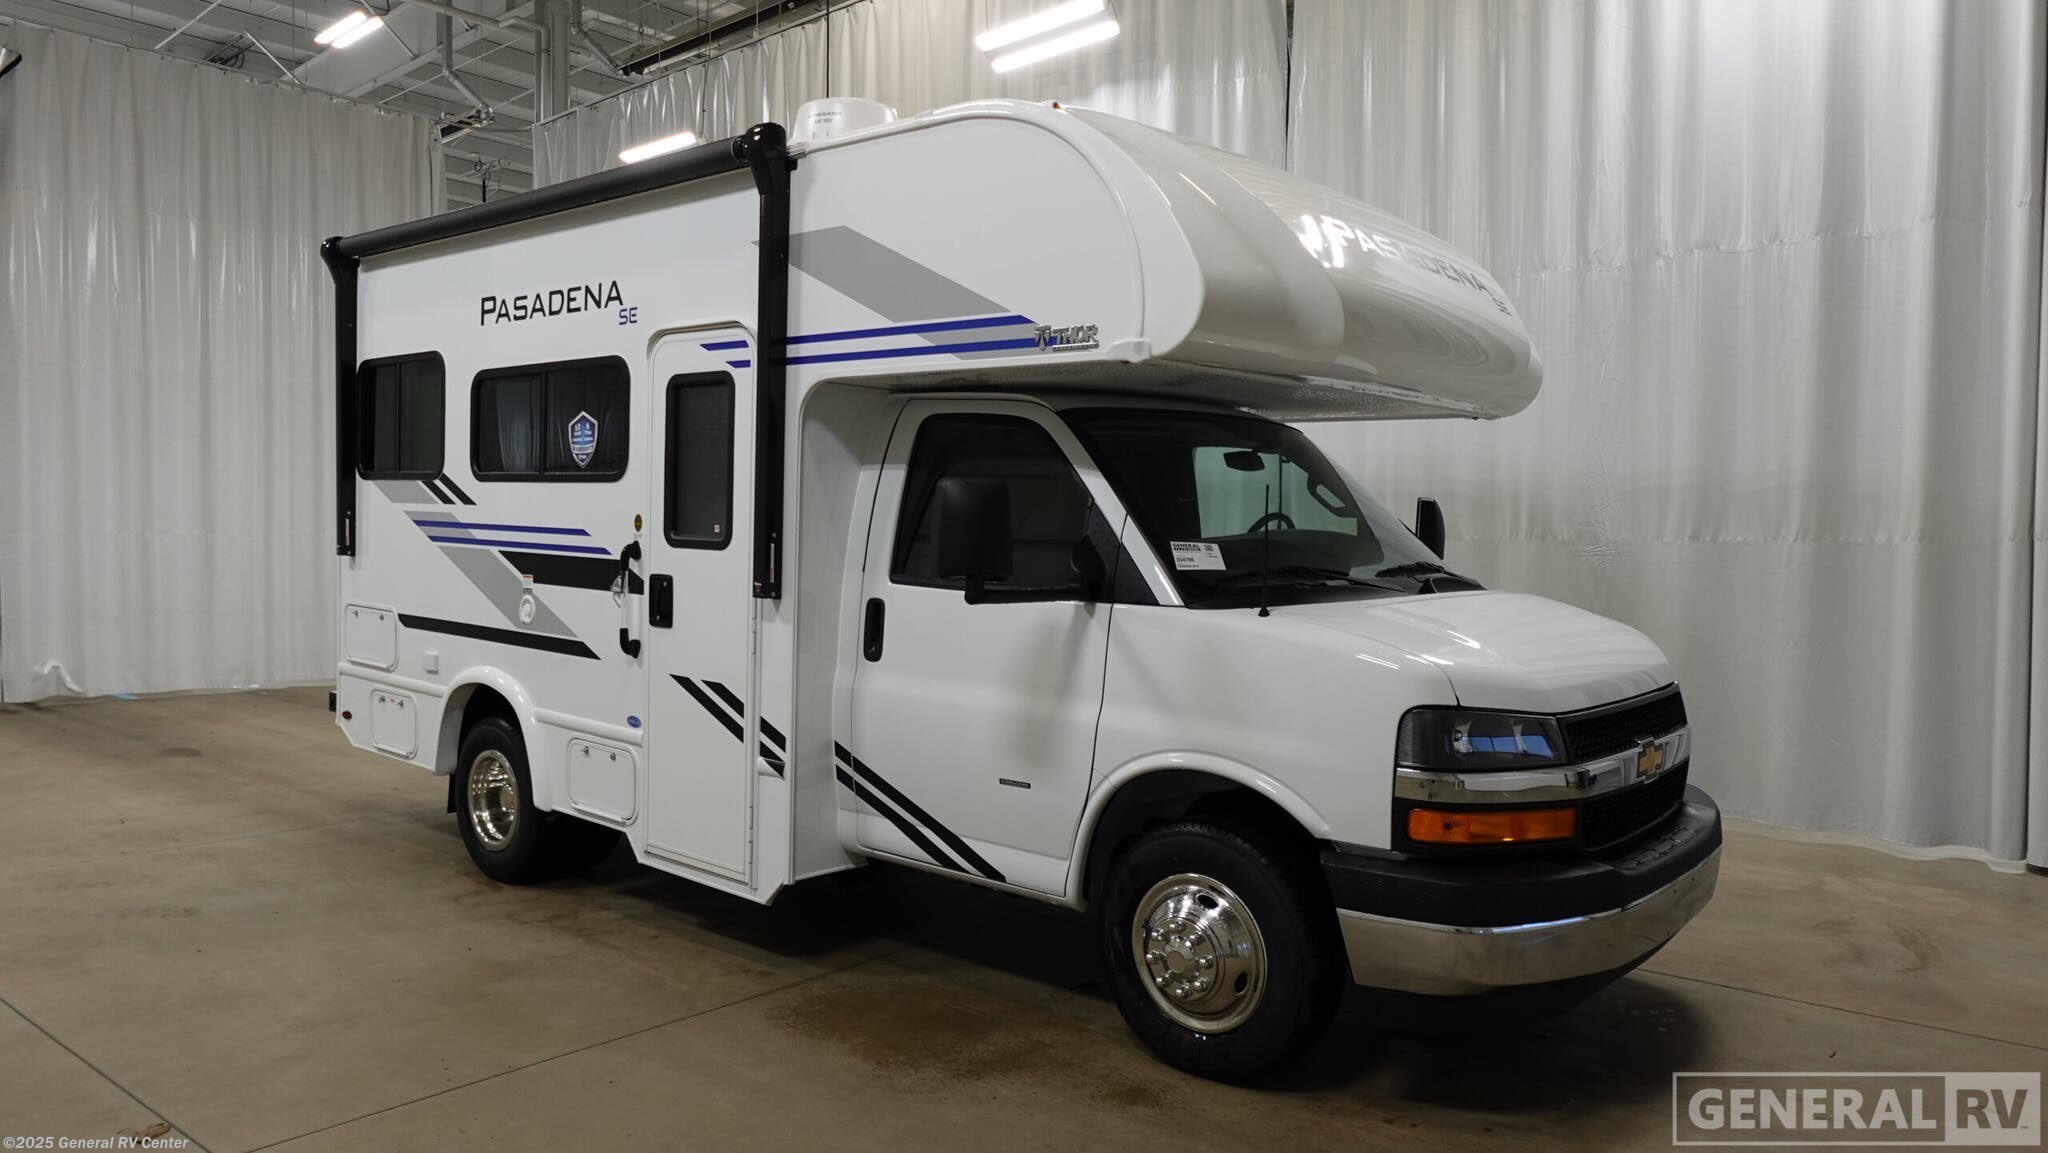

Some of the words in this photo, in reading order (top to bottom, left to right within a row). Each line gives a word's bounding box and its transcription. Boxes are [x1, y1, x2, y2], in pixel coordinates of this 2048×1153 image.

[480, 280, 624, 327] PASADENA
[618, 306, 638, 326] SE
[1053, 324, 1099, 346] THOR
